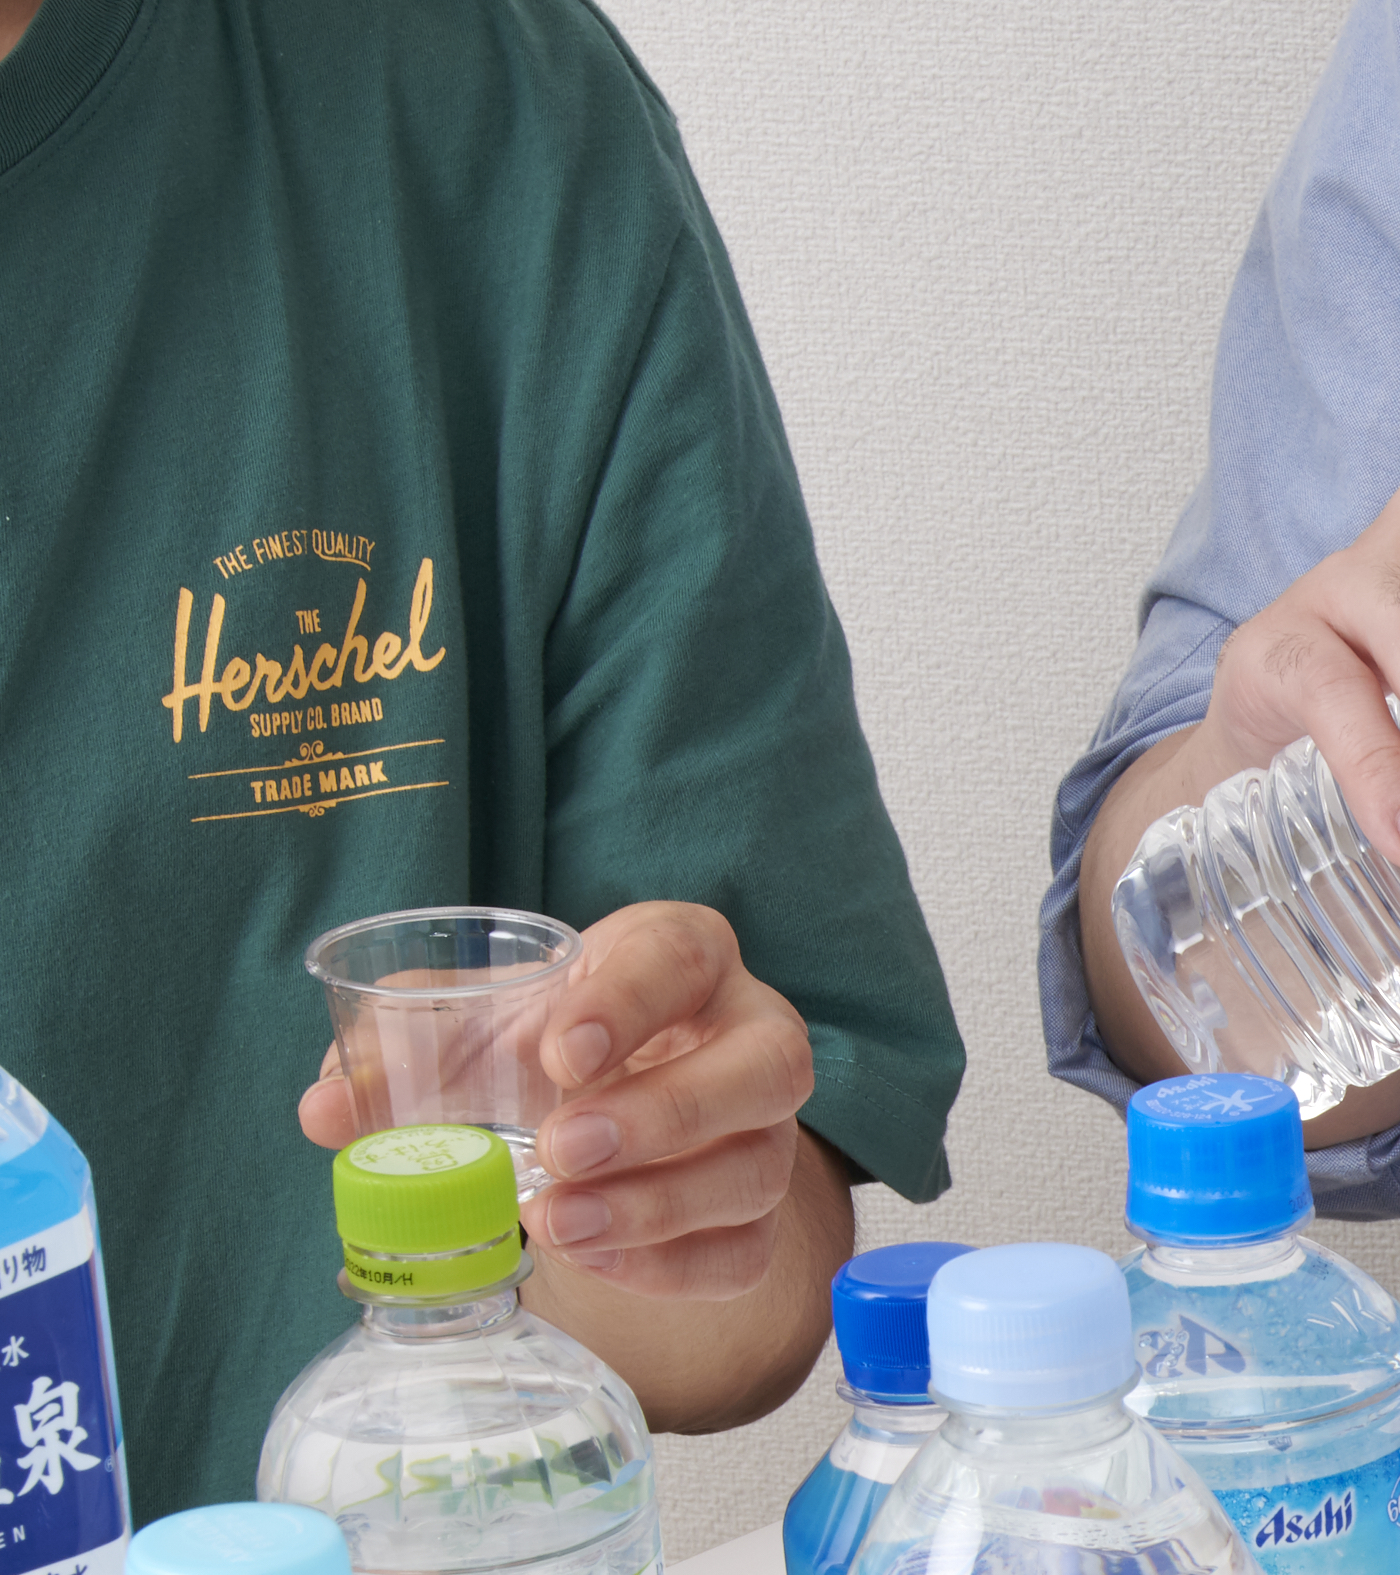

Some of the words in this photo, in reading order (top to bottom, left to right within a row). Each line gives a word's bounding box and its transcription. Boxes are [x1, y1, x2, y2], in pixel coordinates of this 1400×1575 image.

[213, 545, 250, 579] THE
[253, 530, 308, 565] FINEST
[312, 528, 376, 571] QUALITY
[296, 609, 321, 635] THE
[162, 557, 446, 743] Herschel
[250, 710, 304, 738] SUPPLY
[306, 708, 328, 731] CO.
[331, 697, 384, 726] BRAND
[250, 772, 314, 804] TRADE
[318, 760, 389, 794] MARK
[1, 1335, 30, 1368] 水
[0, 1377, 101, 1503] 泉
[1253, 1491, 1354, 1549] Asahi
